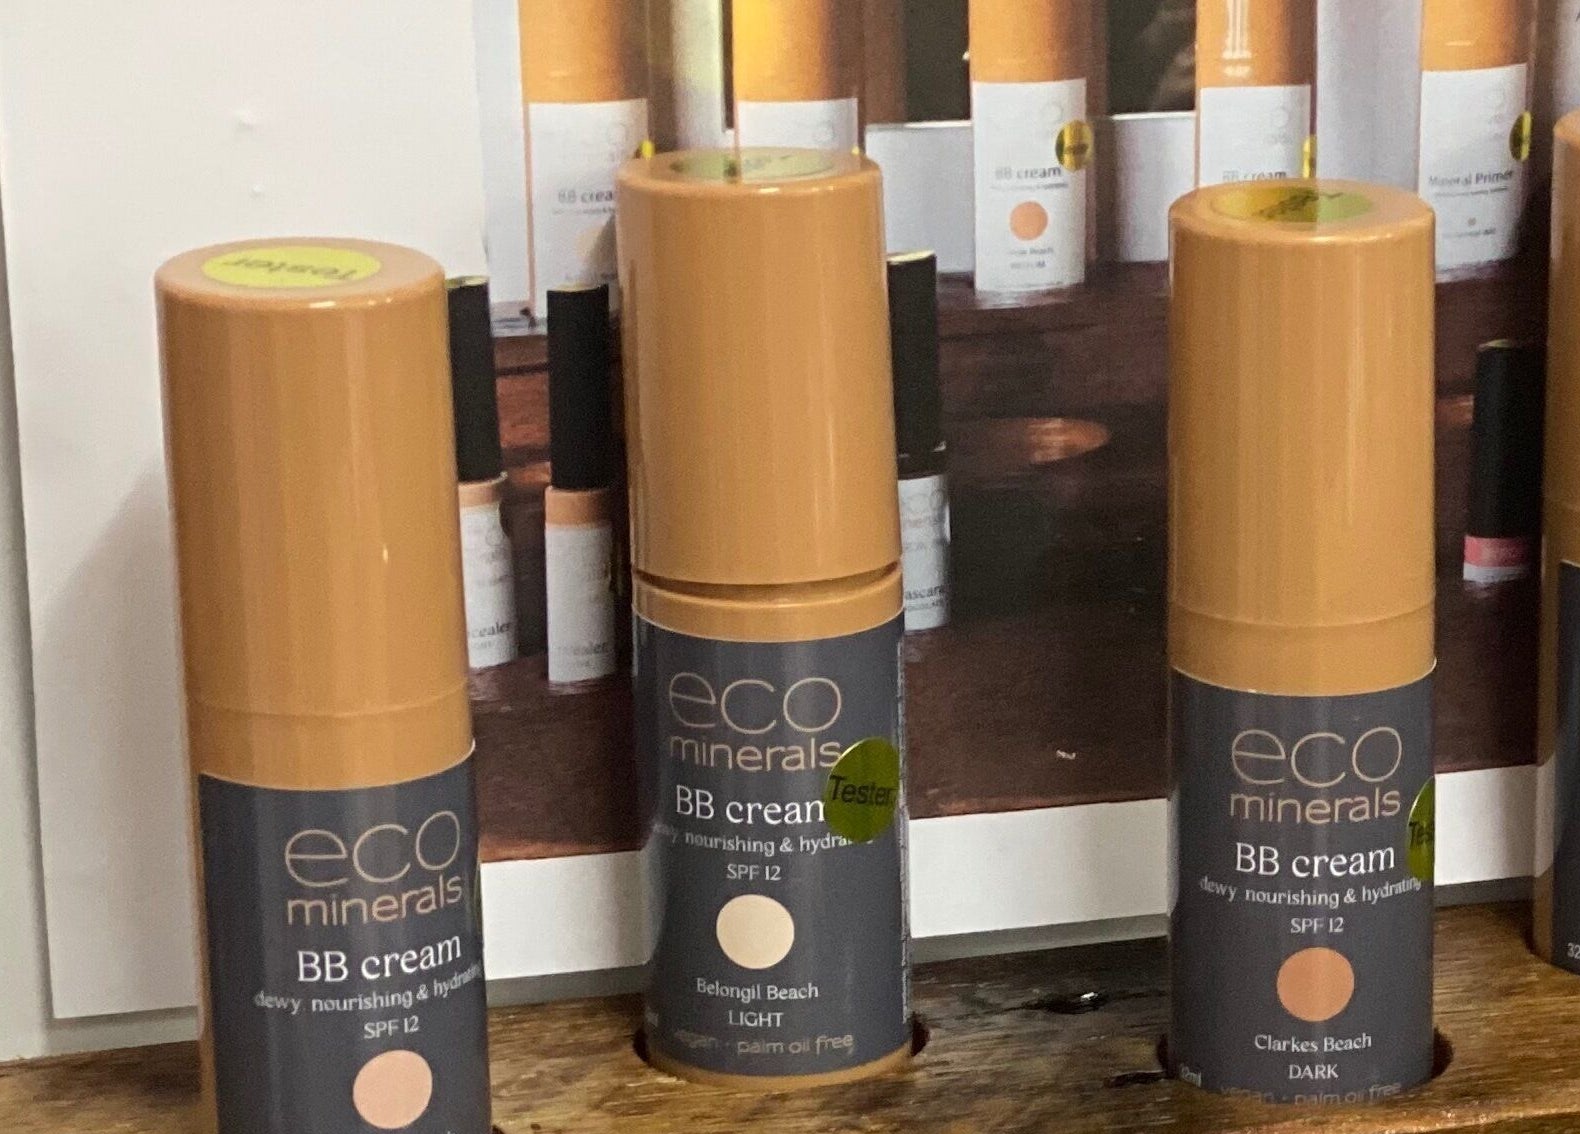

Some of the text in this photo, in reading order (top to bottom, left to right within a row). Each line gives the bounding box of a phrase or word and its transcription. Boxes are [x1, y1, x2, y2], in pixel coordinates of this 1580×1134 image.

[580, 189, 614, 203] crea
[668, 671, 842, 735] eco
[669, 735, 842, 773] minerals
[1231, 726, 1402, 788] eco
[675, 784, 715, 820] BB
[829, 774, 898, 806] Tester
[1229, 786, 1401, 825] minerals
[283, 809, 461, 888] eco
[684, 831, 775, 858] nourishing
[779, 837, 794, 853] &
[799, 832, 852, 856] hydra
[1235, 841, 1395, 878] BB cream
[726, 864, 782, 881] SPF 12
[286, 873, 463, 927] minerals
[1200, 875, 1237, 902] dewy
[1245, 886, 1339, 909] nourishing
[1343, 888, 1357, 904] &
[1290, 916, 1345, 934] SPF 12
[297, 934, 462, 983] BB cream
[254, 989, 301, 1015] dewy
[310, 987, 413, 1013] nourishing
[415, 983, 429, 1001] &
[696, 977, 819, 1004] Belongil Beach
[362, 1015, 420, 1040] SPF 12
[728, 1009, 785, 1028] LIGHT
[1254, 1032, 1373, 1053] Clarkes Beach
[1288, 1063, 1339, 1080] DARK
